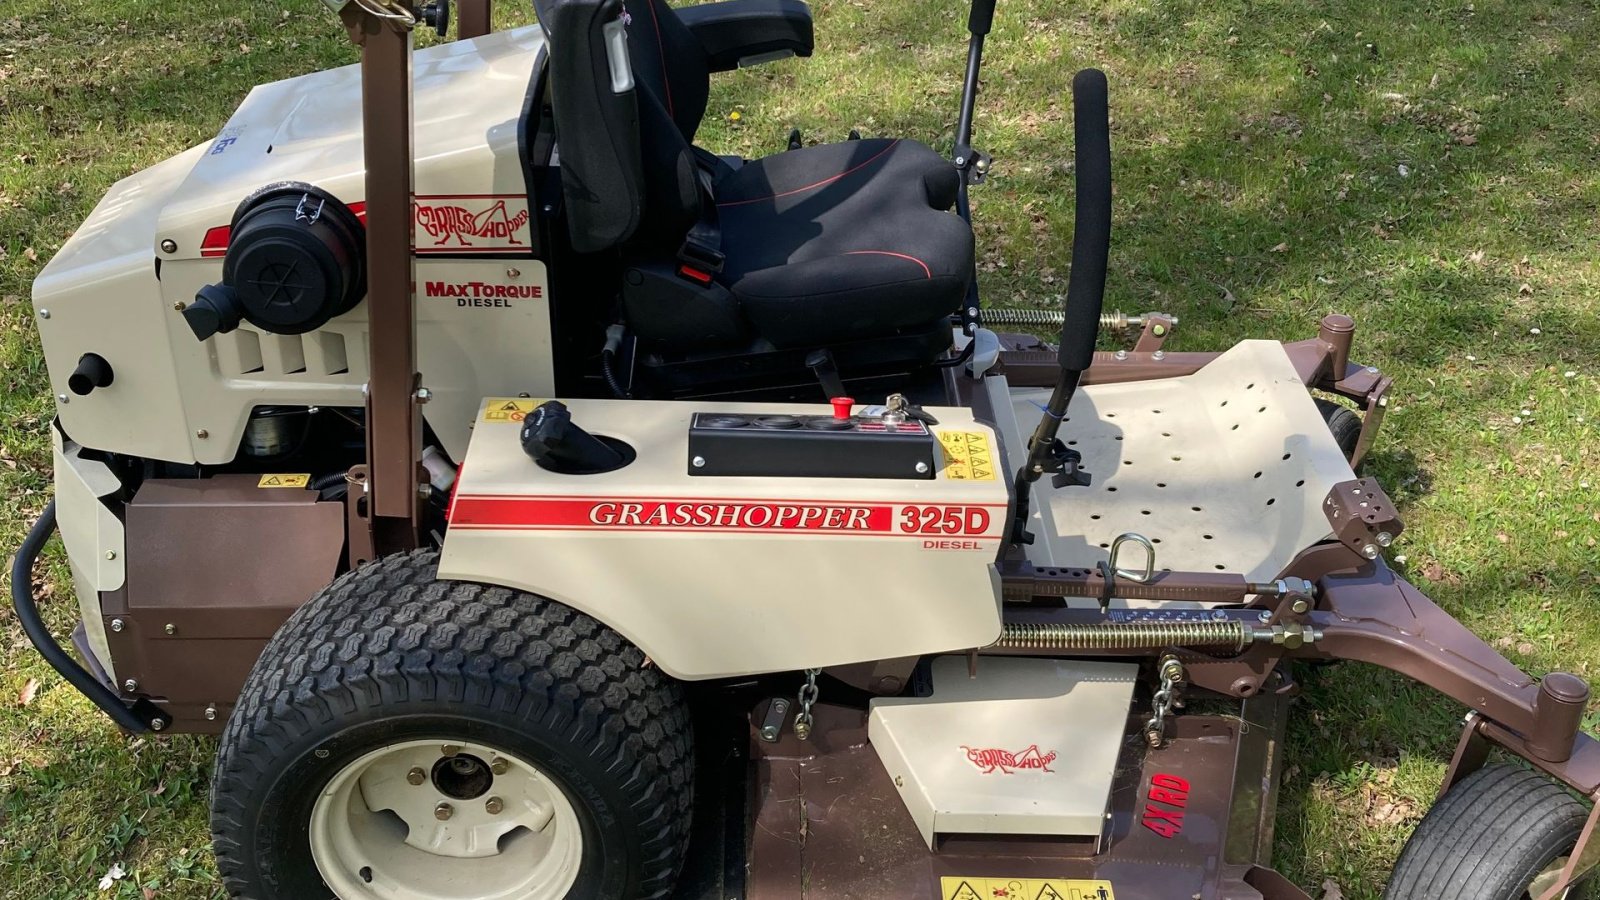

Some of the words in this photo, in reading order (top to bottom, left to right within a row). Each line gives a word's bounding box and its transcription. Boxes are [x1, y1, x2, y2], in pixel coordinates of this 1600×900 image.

[415, 200, 529, 245] GRASSHOPPER
[457, 298, 512, 307] DIESEL
[588, 502, 872, 530] GRASSHOPPER
[900, 505, 990, 534] 325D
[923, 540, 983, 550] DIESEL
